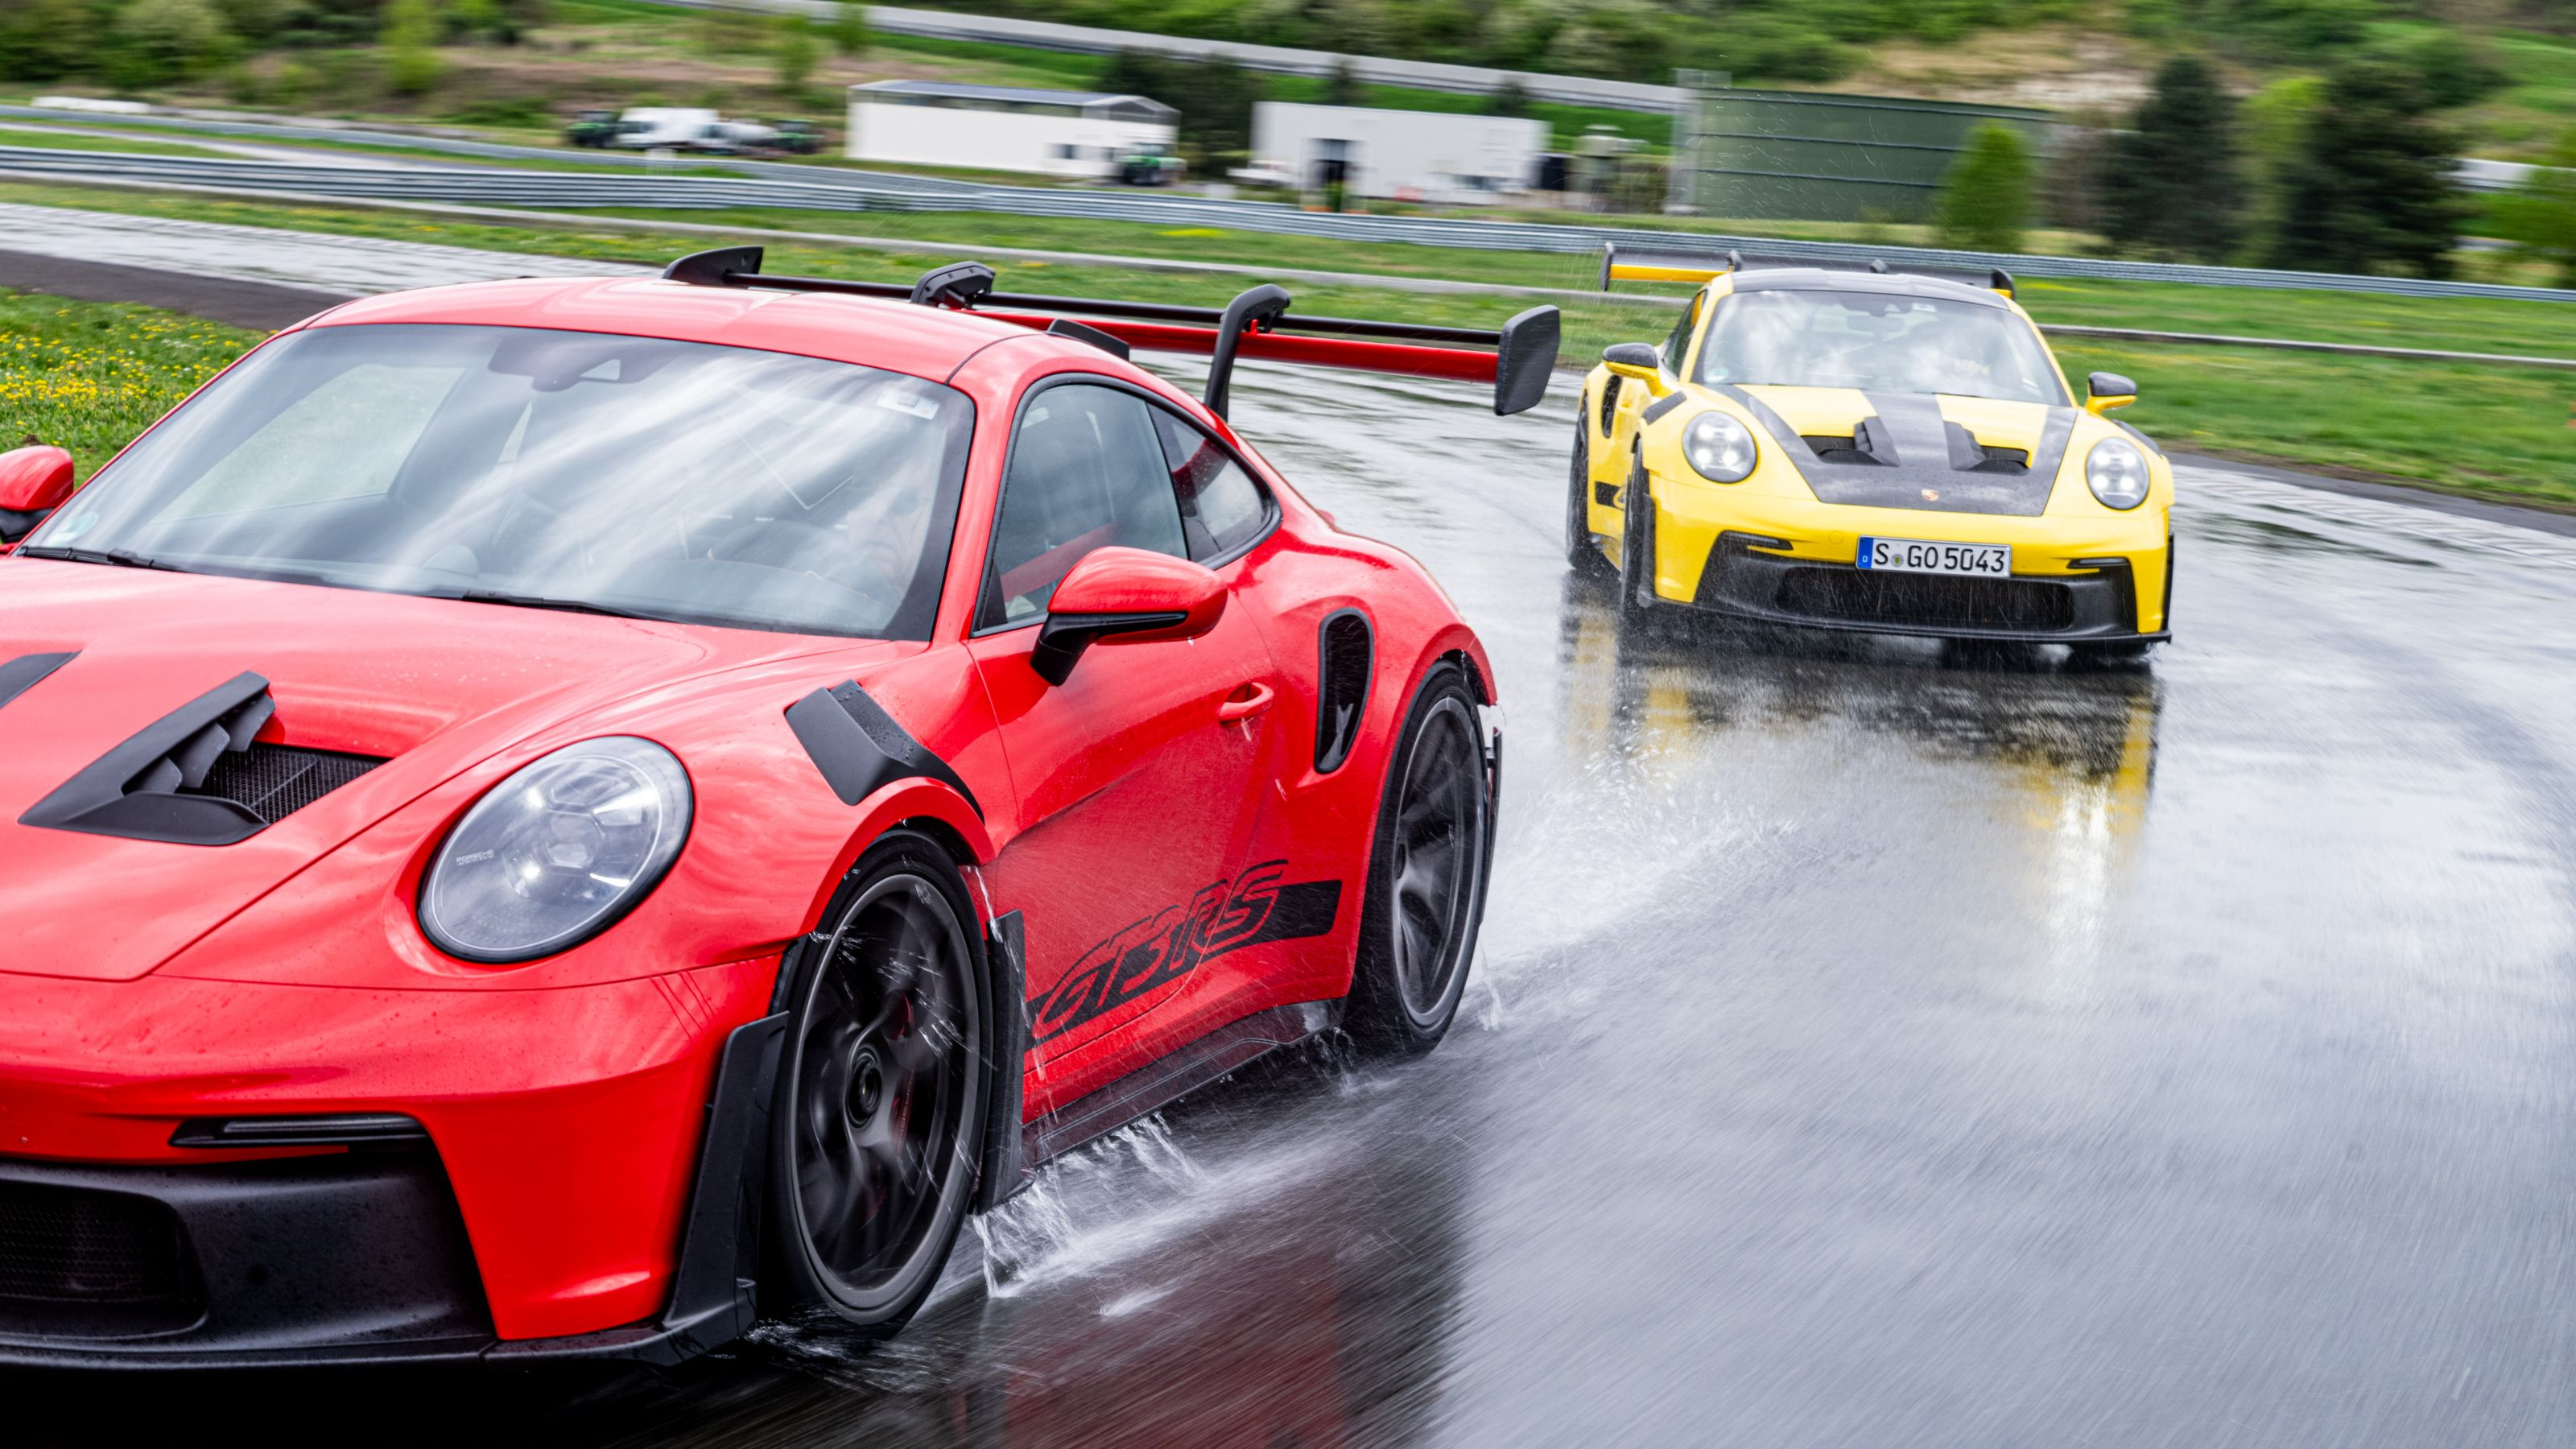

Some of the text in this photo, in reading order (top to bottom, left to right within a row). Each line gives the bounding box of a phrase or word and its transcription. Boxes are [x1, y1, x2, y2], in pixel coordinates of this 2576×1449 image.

[1874, 543, 2004, 573] S GO 5043
